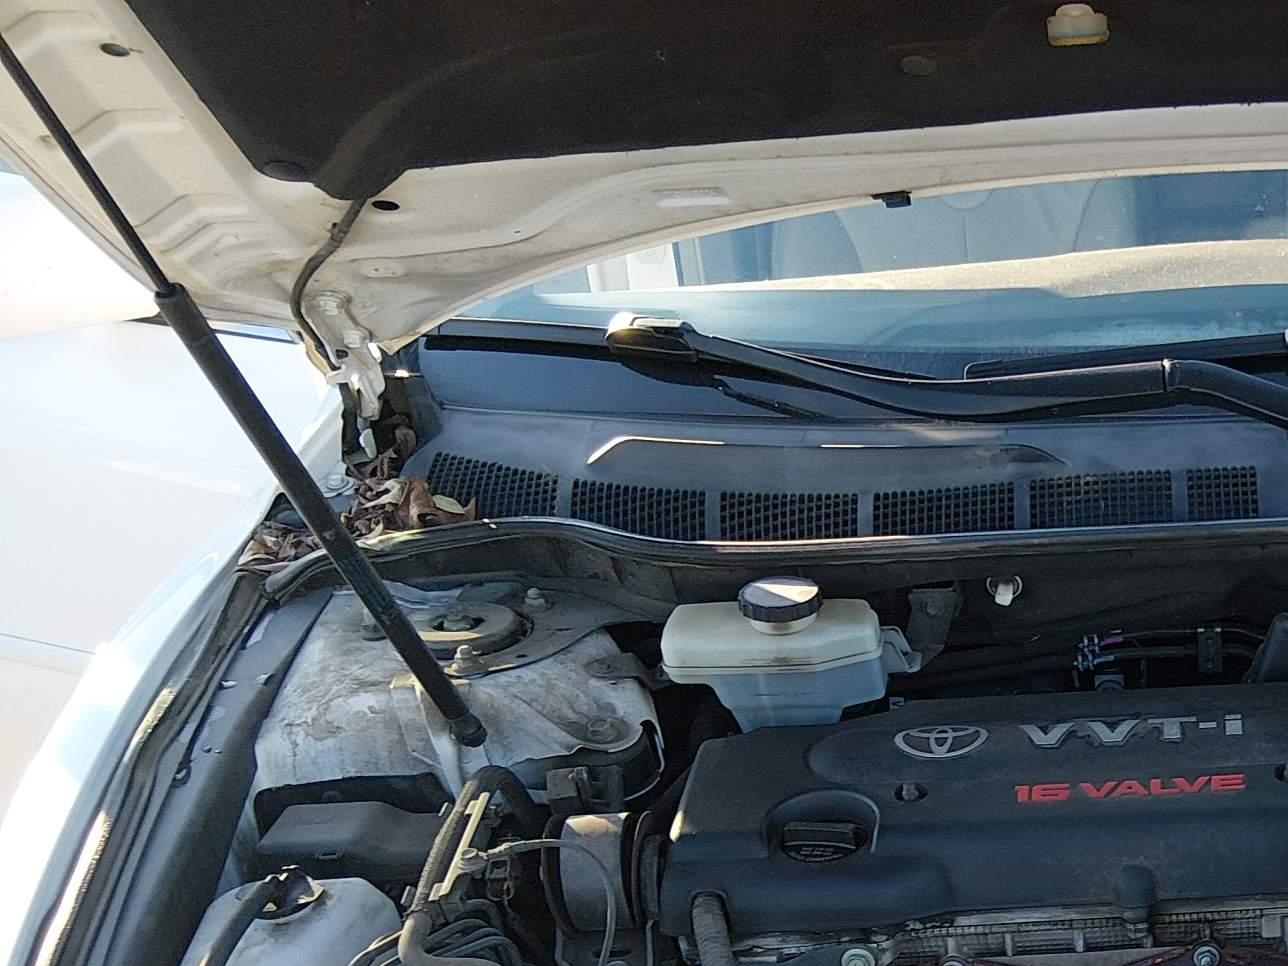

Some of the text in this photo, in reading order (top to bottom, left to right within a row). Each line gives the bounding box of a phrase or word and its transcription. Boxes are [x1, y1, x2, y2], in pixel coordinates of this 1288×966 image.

[1020, 713, 1244, 748] VVT-i
[1014, 774, 1247, 803] 16 VALVE
